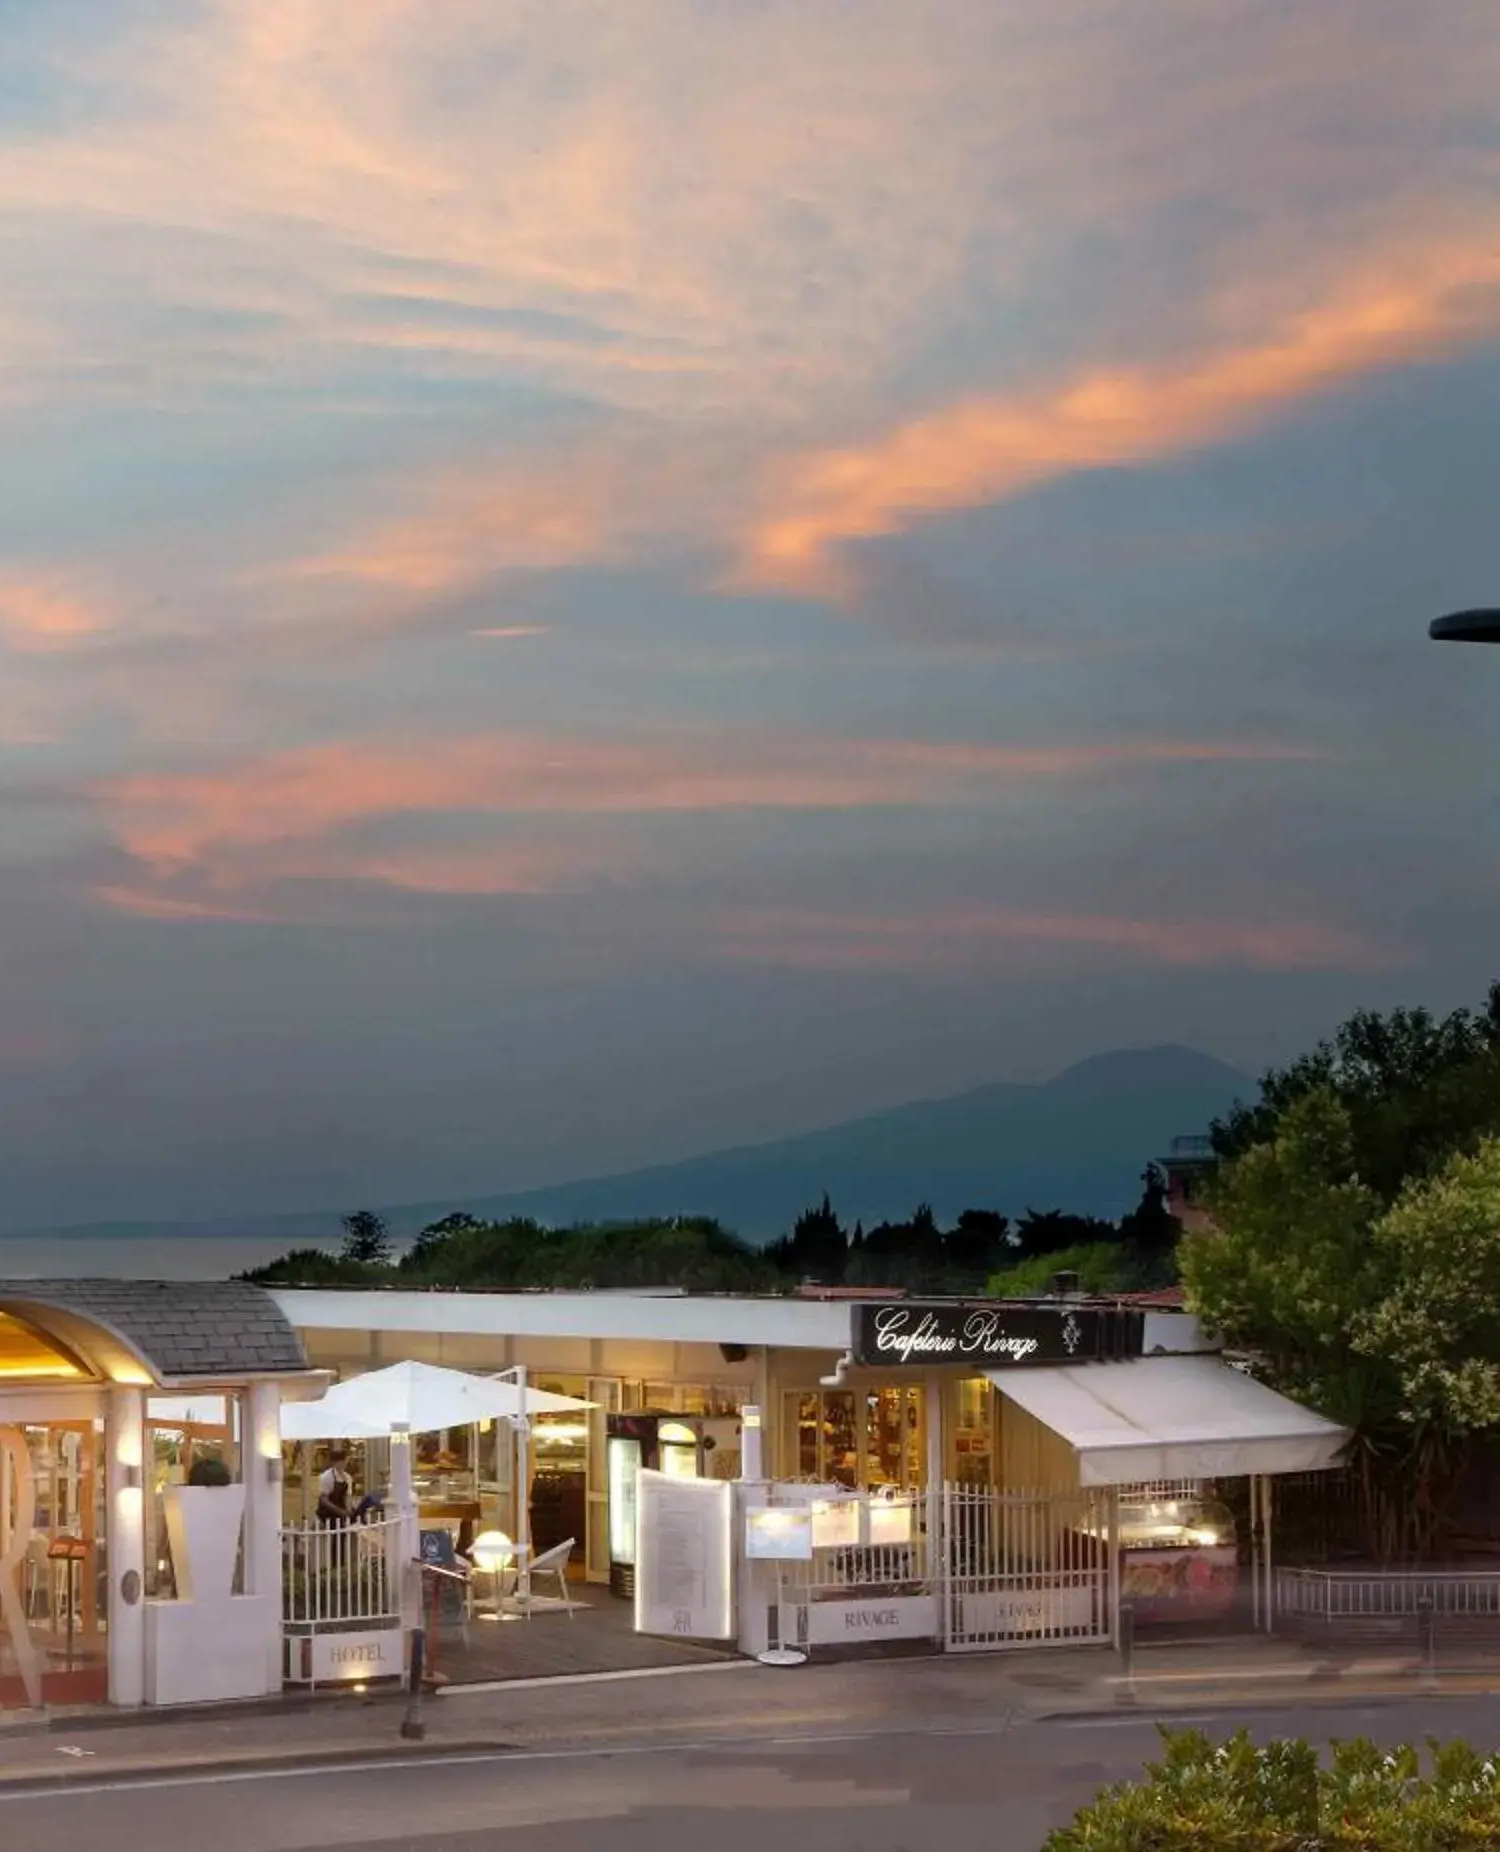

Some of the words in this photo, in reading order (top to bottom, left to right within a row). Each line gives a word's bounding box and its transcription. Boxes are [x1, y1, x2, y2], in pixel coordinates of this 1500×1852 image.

[959, 1309, 1038, 1360] Rivage
[844, 1608, 901, 1630] RIVAGE
[331, 1644, 387, 1663] HOTEL
